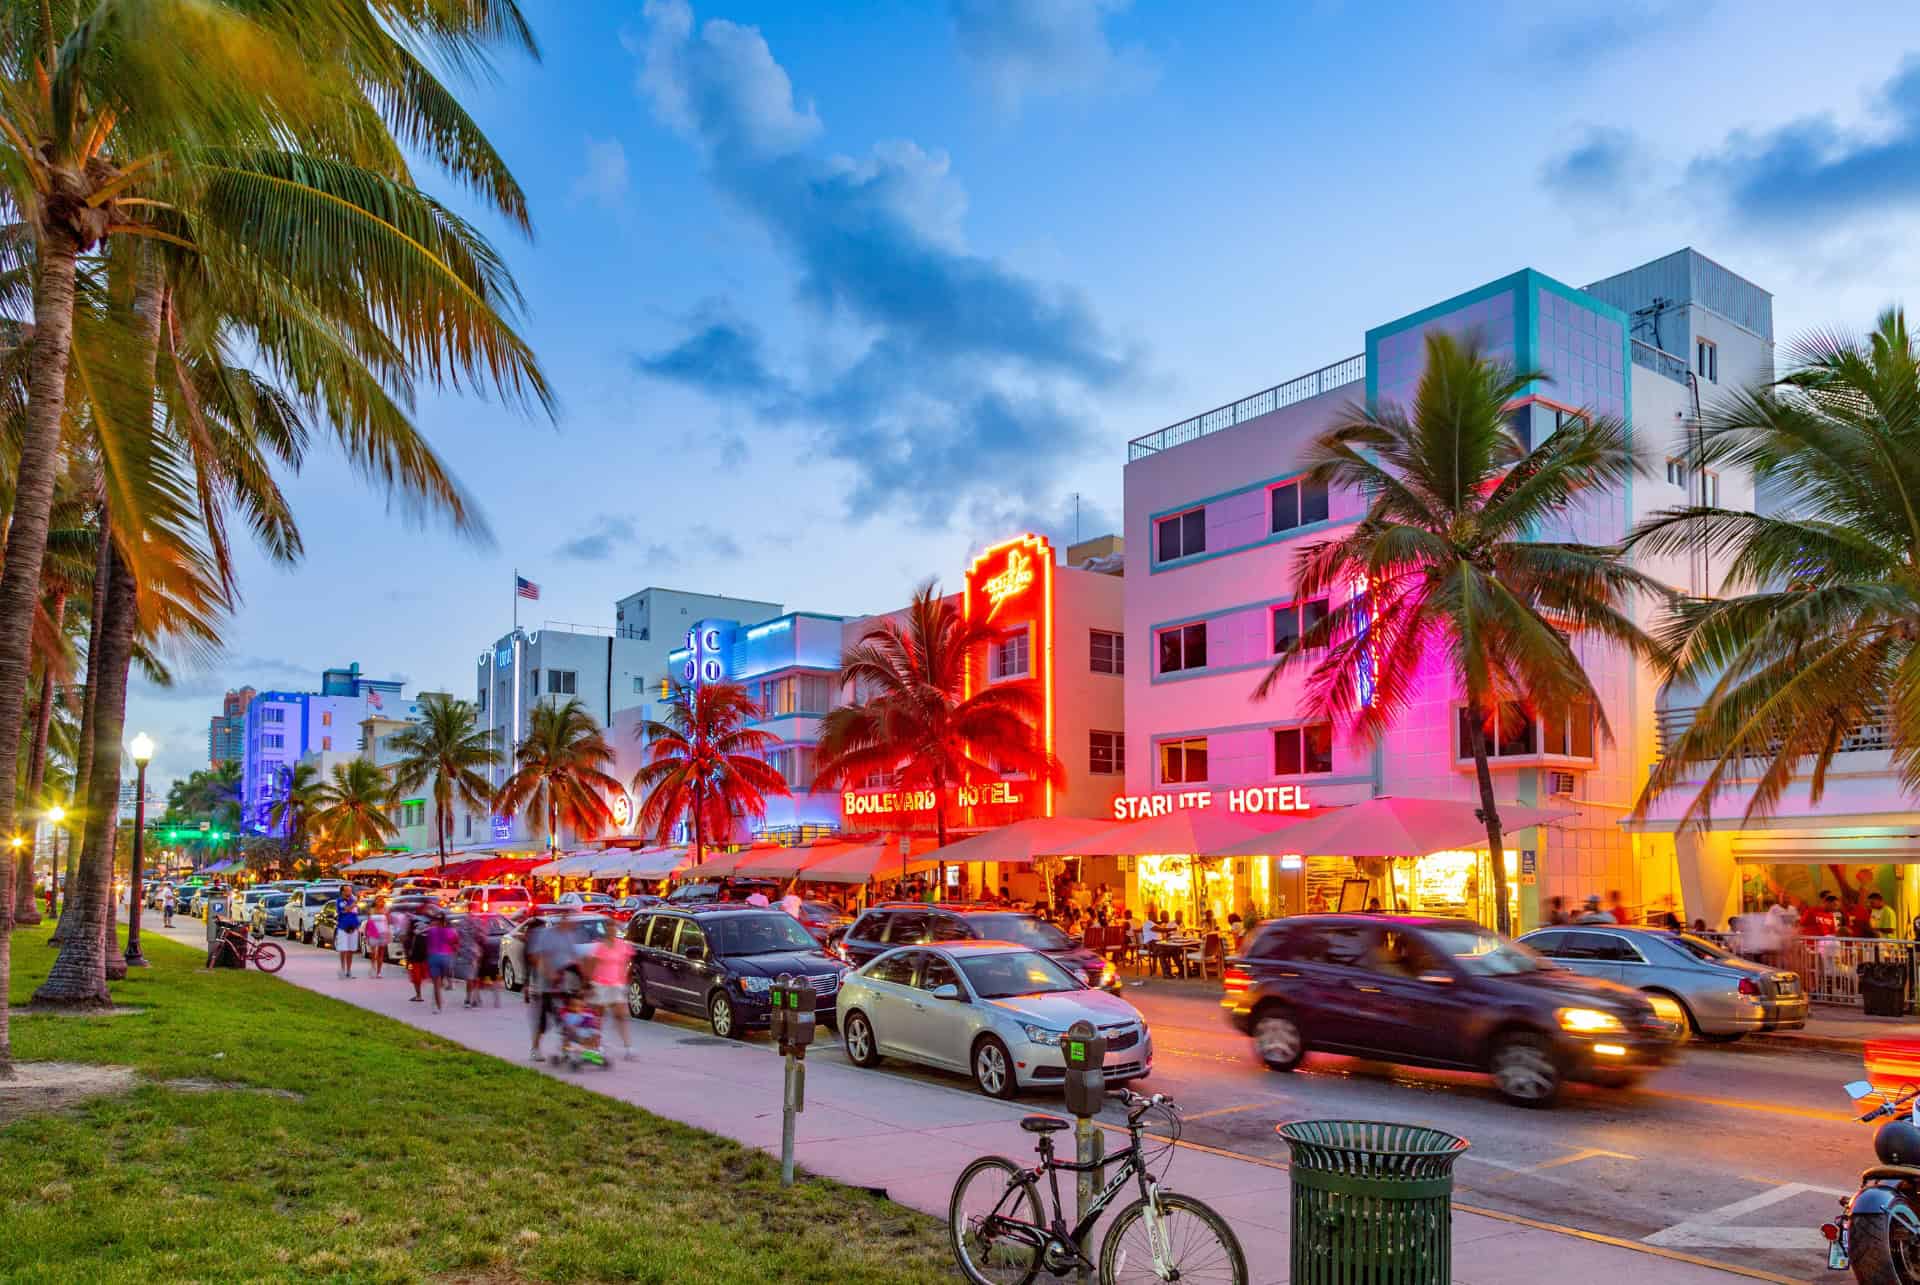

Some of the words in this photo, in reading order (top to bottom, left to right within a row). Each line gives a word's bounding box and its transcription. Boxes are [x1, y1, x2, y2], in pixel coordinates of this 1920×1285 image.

[844, 790, 936, 815] BOULEVARD
[958, 782, 1019, 807] HOTEL
[1229, 785, 1311, 813] HOTEL
